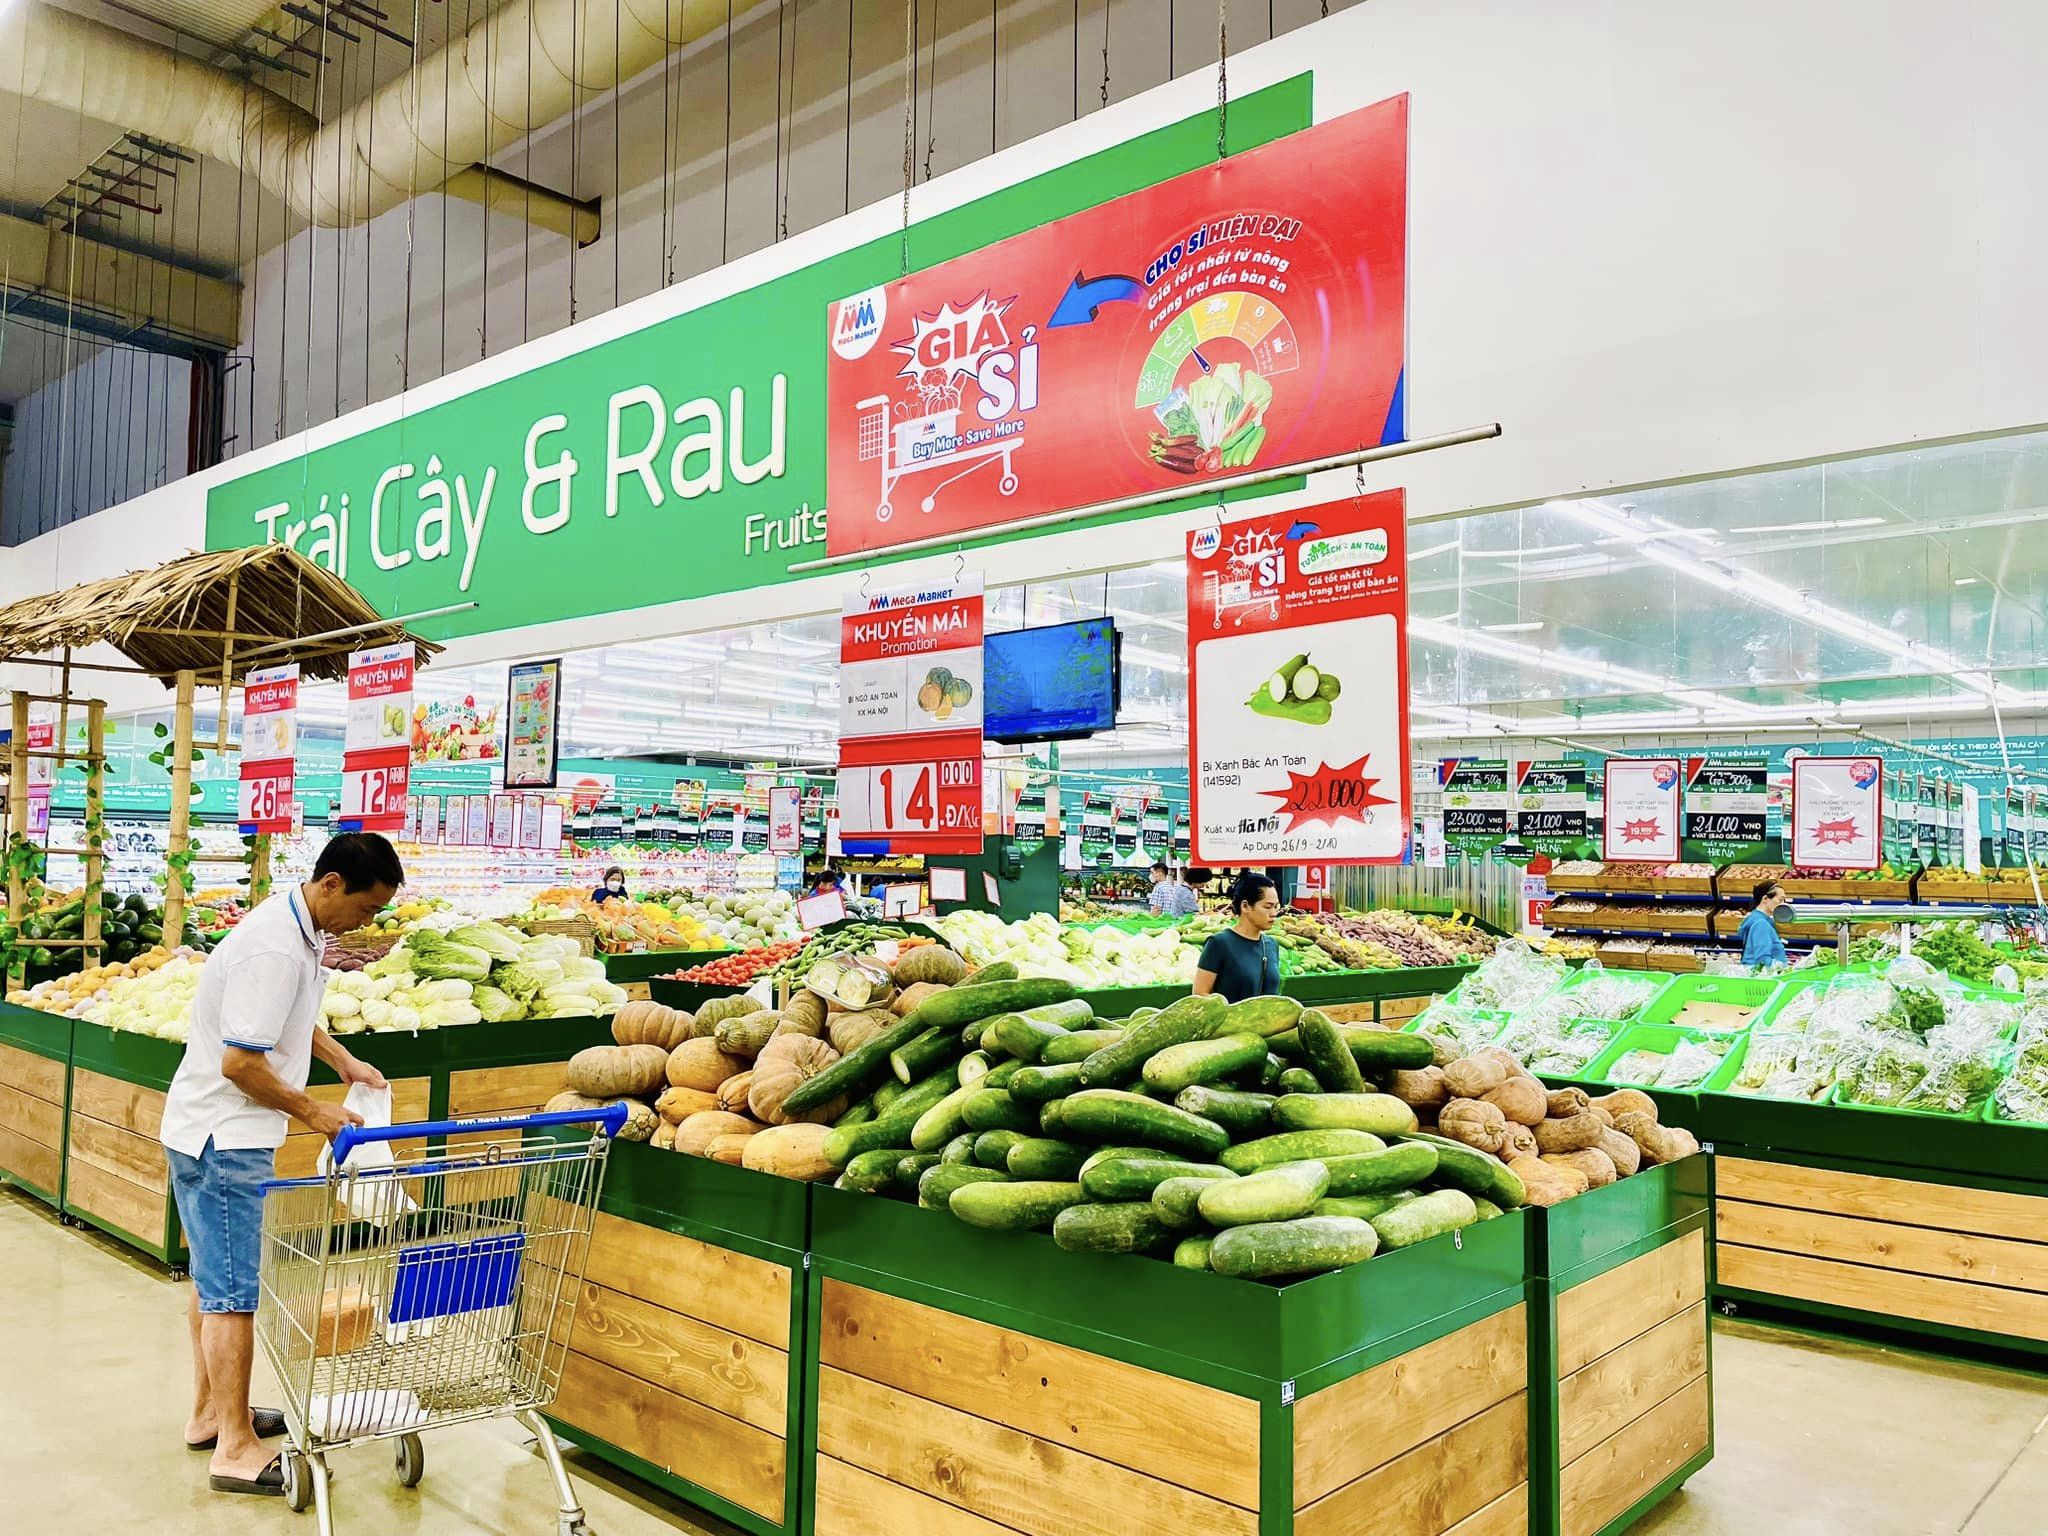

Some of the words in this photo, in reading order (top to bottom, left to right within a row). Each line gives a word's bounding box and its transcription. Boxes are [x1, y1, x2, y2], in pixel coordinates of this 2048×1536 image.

[1145, 241, 1184, 286] CHỢ
[1207, 213, 1260, 244] HIỆN
[1260, 215, 1303, 243] ĐẠI
[1147, 279, 1172, 310] Giá
[1174, 262, 1194, 288] tốt
[1197, 248, 1231, 273] nhất
[1252, 250, 1290, 273] nông
[1149, 297, 1182, 332] trang
[1185, 275, 1209, 300] trại
[1213, 267, 1236, 287] đến
[1240, 269, 1265, 285] bàn
[913, 442, 934, 460] Buy
[935, 435, 963, 453] More
[966, 428, 992, 445] Save
[994, 419, 1025, 437] More
[370, 454, 497, 592] Cây
[521, 414, 579, 535] &
[604, 373, 788, 517] Rau
[744, 502, 827, 555] Fruits
[1350, 542, 1362, 550] AN
[1308, 576, 1322, 586] Giá
[1324, 572, 1338, 583] tốt
[1340, 568, 1360, 581] nhất
[1285, 590, 1307, 601] nông
[1309, 586, 1333, 598] trang
[854, 608, 927, 644] KHUYẾN
[932, 605, 968, 633] MÃI
[880, 638, 938, 655] Promotion
[354, 664, 389, 688] KHUYẾN
[249, 682, 278, 705] KHUYẾN
[869, 692, 879, 701] AN
[1215, 760, 1240, 771] Xanh
[1264, 757, 1279, 767] An
[361, 771, 385, 813] 12
[1203, 775, 1241, 788] (141592)
[251, 780, 274, 818] 26
[880, 766, 934, 830] 14
[943, 762, 972, 784] 000
[1447, 811, 1486, 826] 23.000
[1523, 814, 1562, 830] 21.000
[1743, 822, 1762, 830] VND
